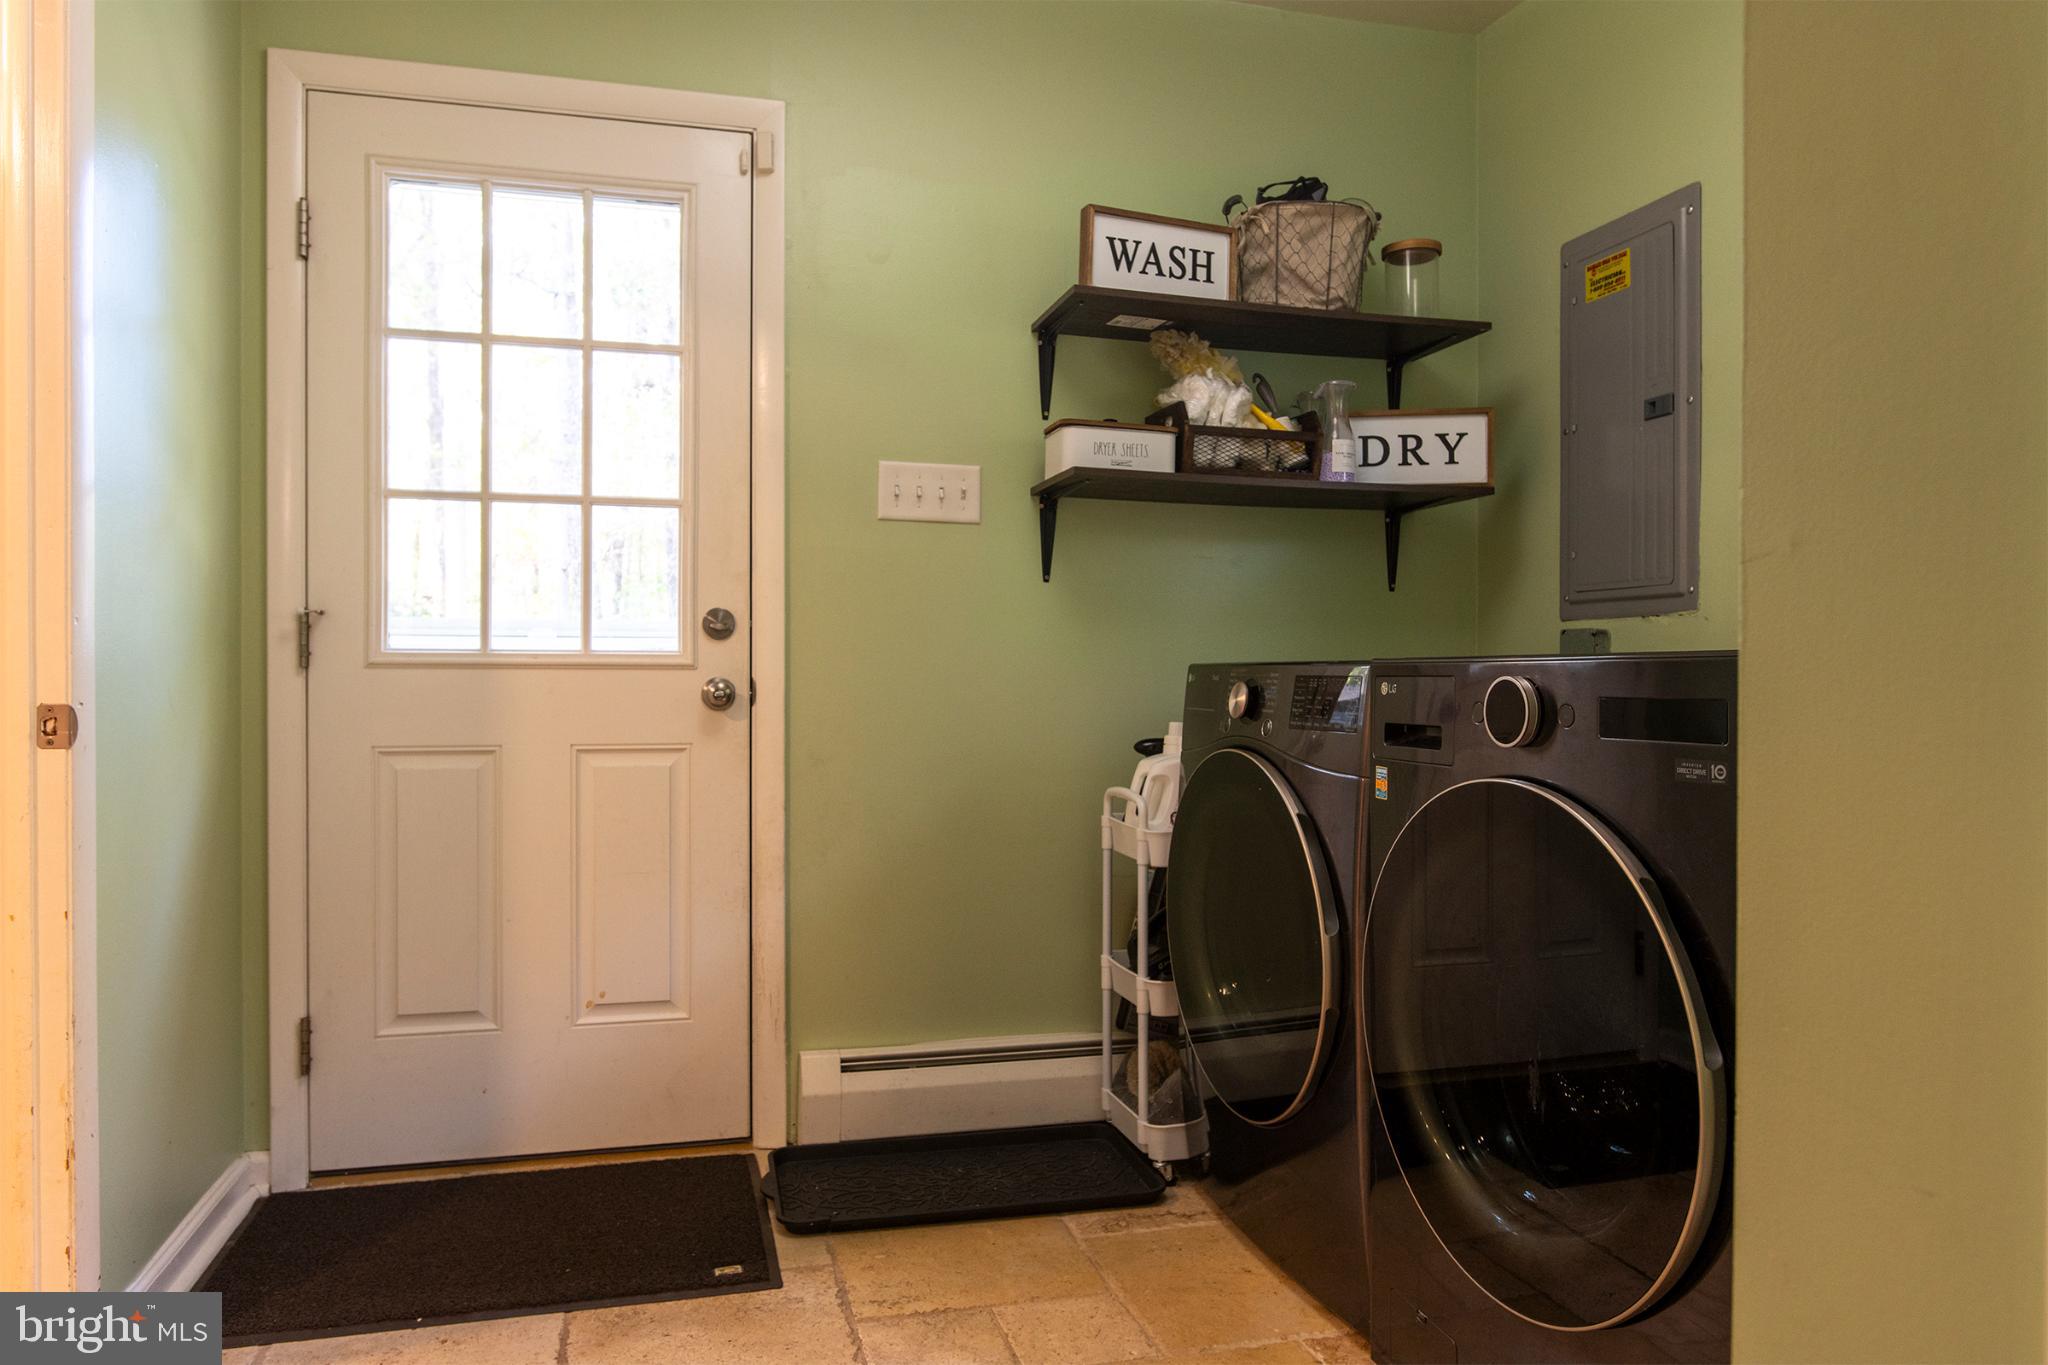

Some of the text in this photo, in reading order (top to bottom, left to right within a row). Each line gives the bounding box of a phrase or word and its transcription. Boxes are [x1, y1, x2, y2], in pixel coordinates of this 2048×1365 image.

[1105, 236, 1215, 284] WASH
[1093, 441, 1149, 458] DRYER SHEETS
[1358, 432, 1469, 468] DRY
[1711, 764, 1727, 780] 10
